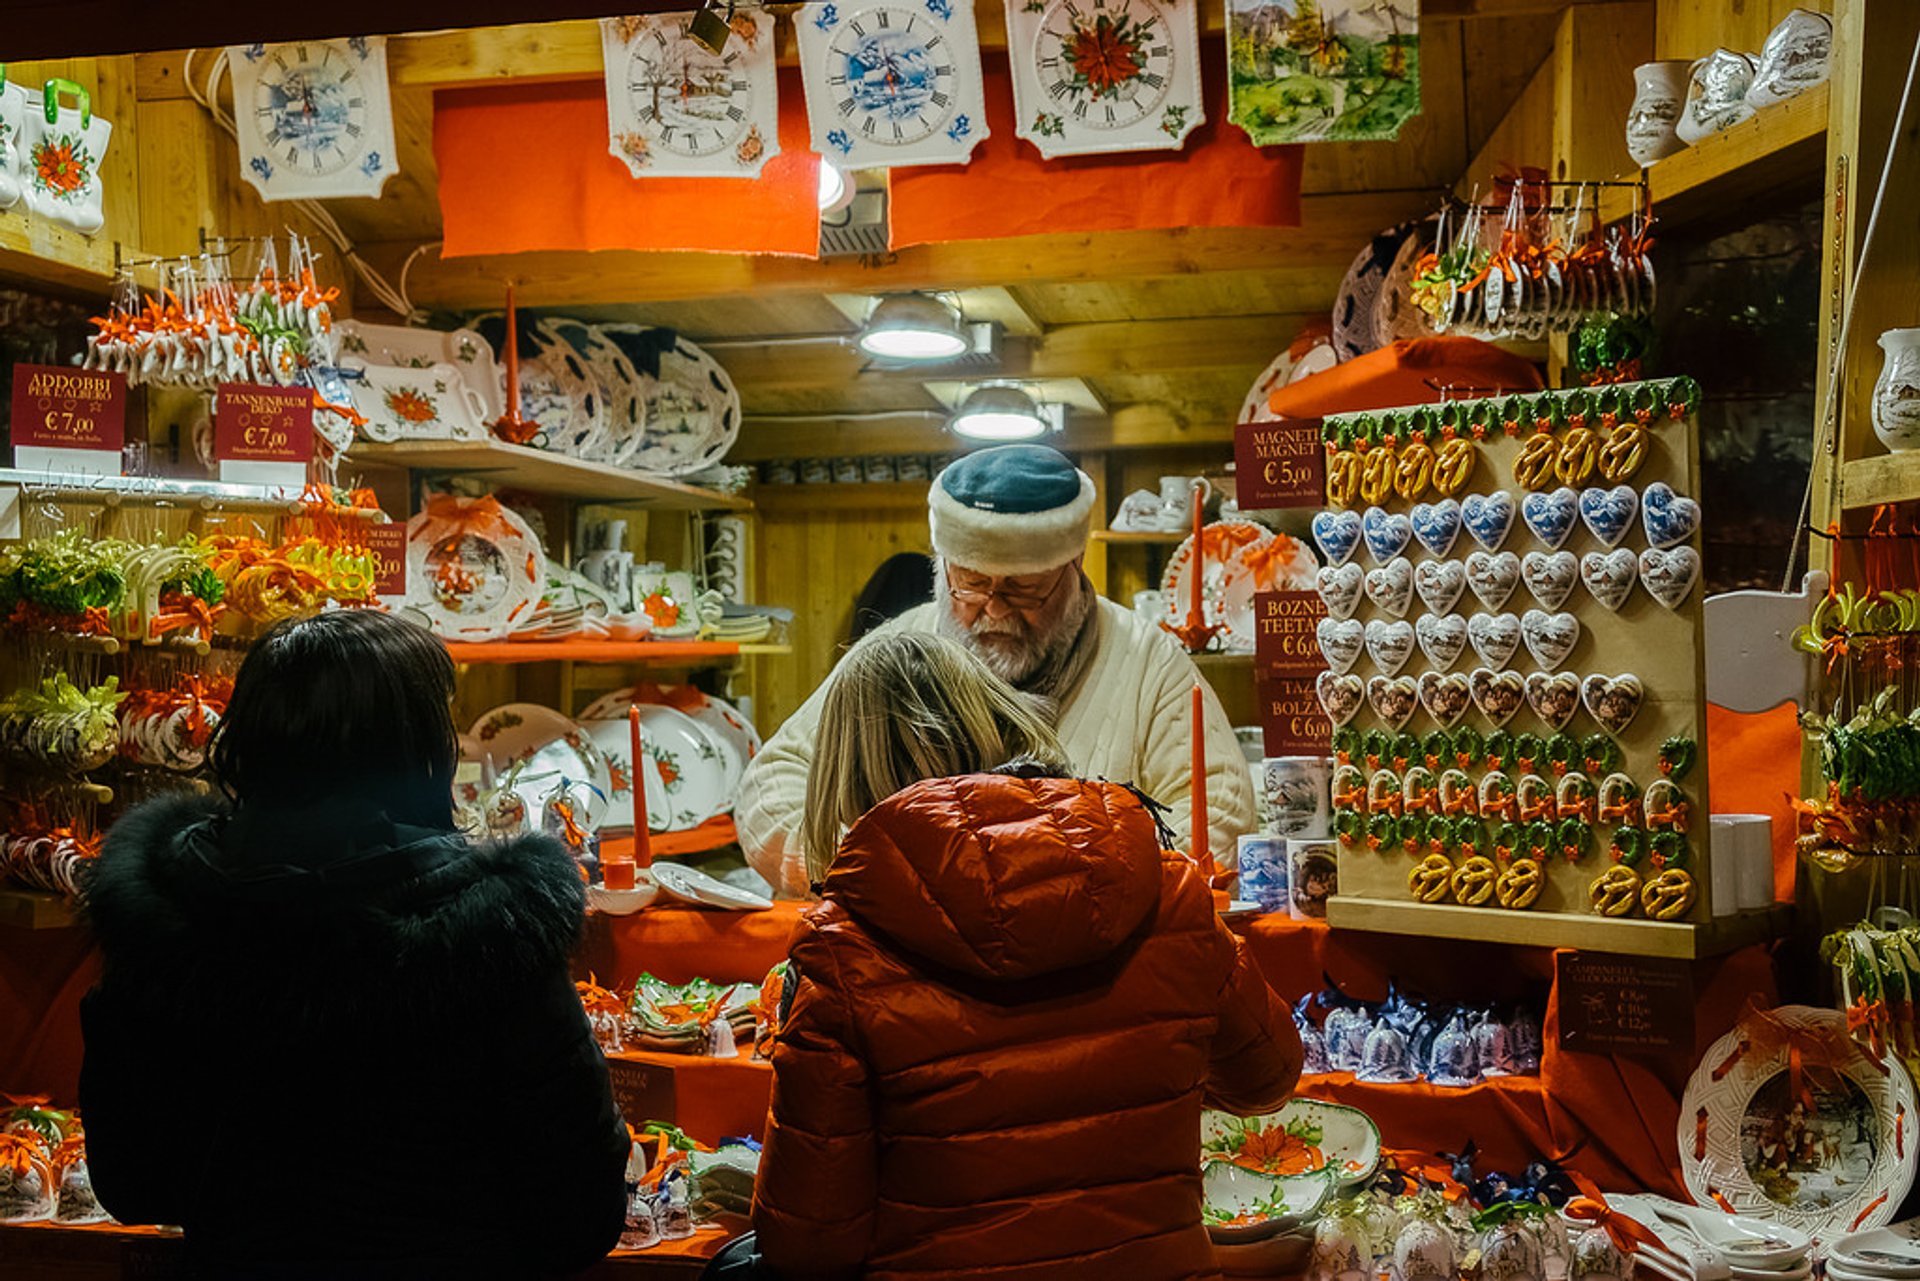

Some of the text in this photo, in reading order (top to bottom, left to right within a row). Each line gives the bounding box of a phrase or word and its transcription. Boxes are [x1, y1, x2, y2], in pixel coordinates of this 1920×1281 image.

[30, 374, 110, 390] ADDOBBI
[28, 386, 50, 397] PER
[225, 394, 307, 408] TANNENBAUM
[251, 404, 282, 414] DEKO
[1254, 428, 1319, 445] MAGNETI
[1256, 443, 1317, 459] MAGNET
[1282, 681, 1316, 695] TAZ
[1272, 701, 1325, 716] BOLZA
